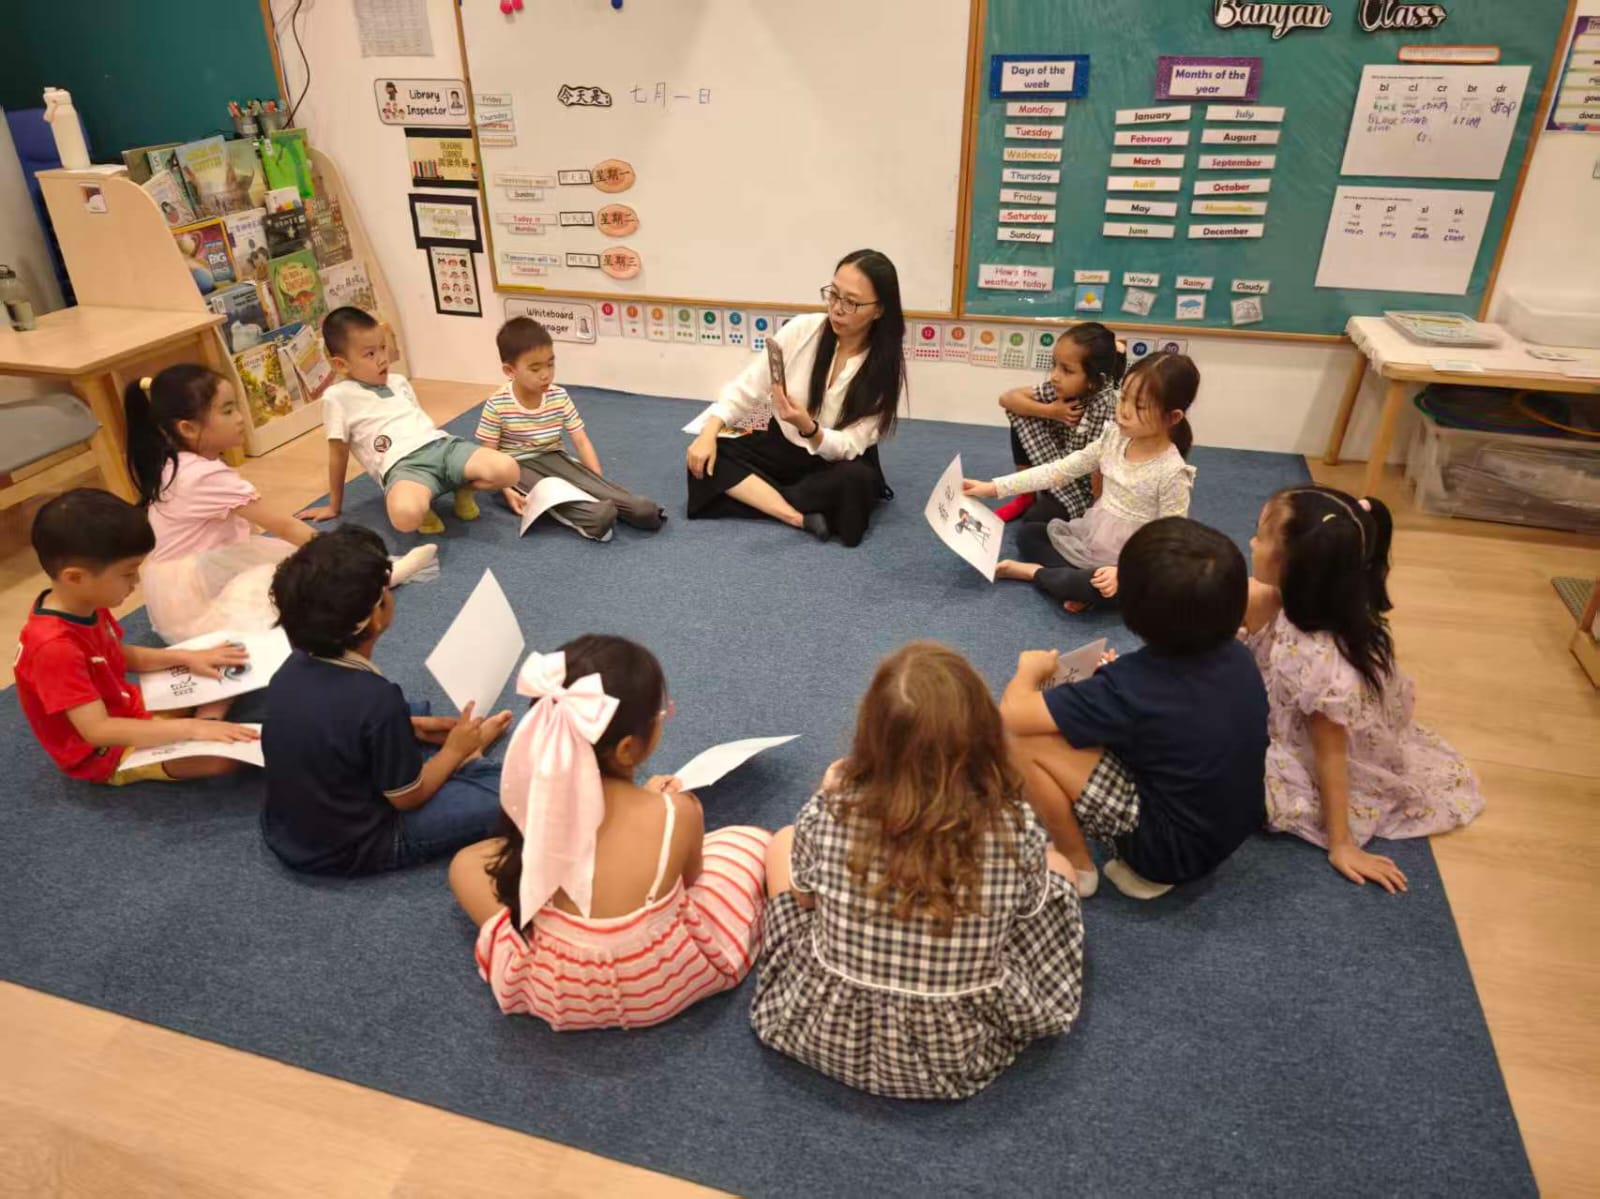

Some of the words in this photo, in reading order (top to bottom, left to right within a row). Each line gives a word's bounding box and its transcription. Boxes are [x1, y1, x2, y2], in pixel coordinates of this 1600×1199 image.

[1215, 0, 1329, 38] Banyan
[1358, 0, 1443, 32] Class
[1011, 66, 1035, 76] Days
[1037, 66, 1048, 75] of
[1050, 66, 1066, 75] the
[1175, 69, 1213, 80] Months
[1215, 69, 1227, 80] of
[1228, 71, 1246, 80] the
[1024, 79, 1050, 89] week
[1195, 85, 1220, 95] year
[1379, 84, 1390, 92] bl
[409, 89, 441, 103] Library
[406, 104, 447, 117] Inspector
[1018, 105, 1055, 115] Monday
[1235, 108, 1255, 120] July
[1134, 111, 1172, 122] January
[1015, 126, 1054, 138] Tuesday
[1222, 132, 1257, 144] August
[1129, 133, 1173, 145] February
[1006, 149, 1059, 160] Wednesday
[1132, 156, 1162, 166] March
[1211, 156, 1262, 168] September
[595, 167, 631, 183] 星期一
[1010, 171, 1052, 182] Thursday
[1212, 182, 1250, 192] October
[1013, 191, 1043, 204] Friday
[1130, 203, 1150, 215] May
[600, 211, 636, 225] 星期二
[1006, 211, 1049, 223] Saturday
[1009, 230, 1042, 241] Sunday
[1128, 225, 1149, 236] June
[1202, 226, 1249, 237] December
[602, 253, 638, 267] 星期三
[1023, 268, 1038, 277] the
[983, 279, 1019, 288] weather
[1023, 279, 1048, 289] today
[1128, 274, 1154, 286] Windy
[1182, 278, 1207, 290] Rainy
[1236, 282, 1265, 294] Cloudy
[526, 306, 574, 320] Whiteboard
